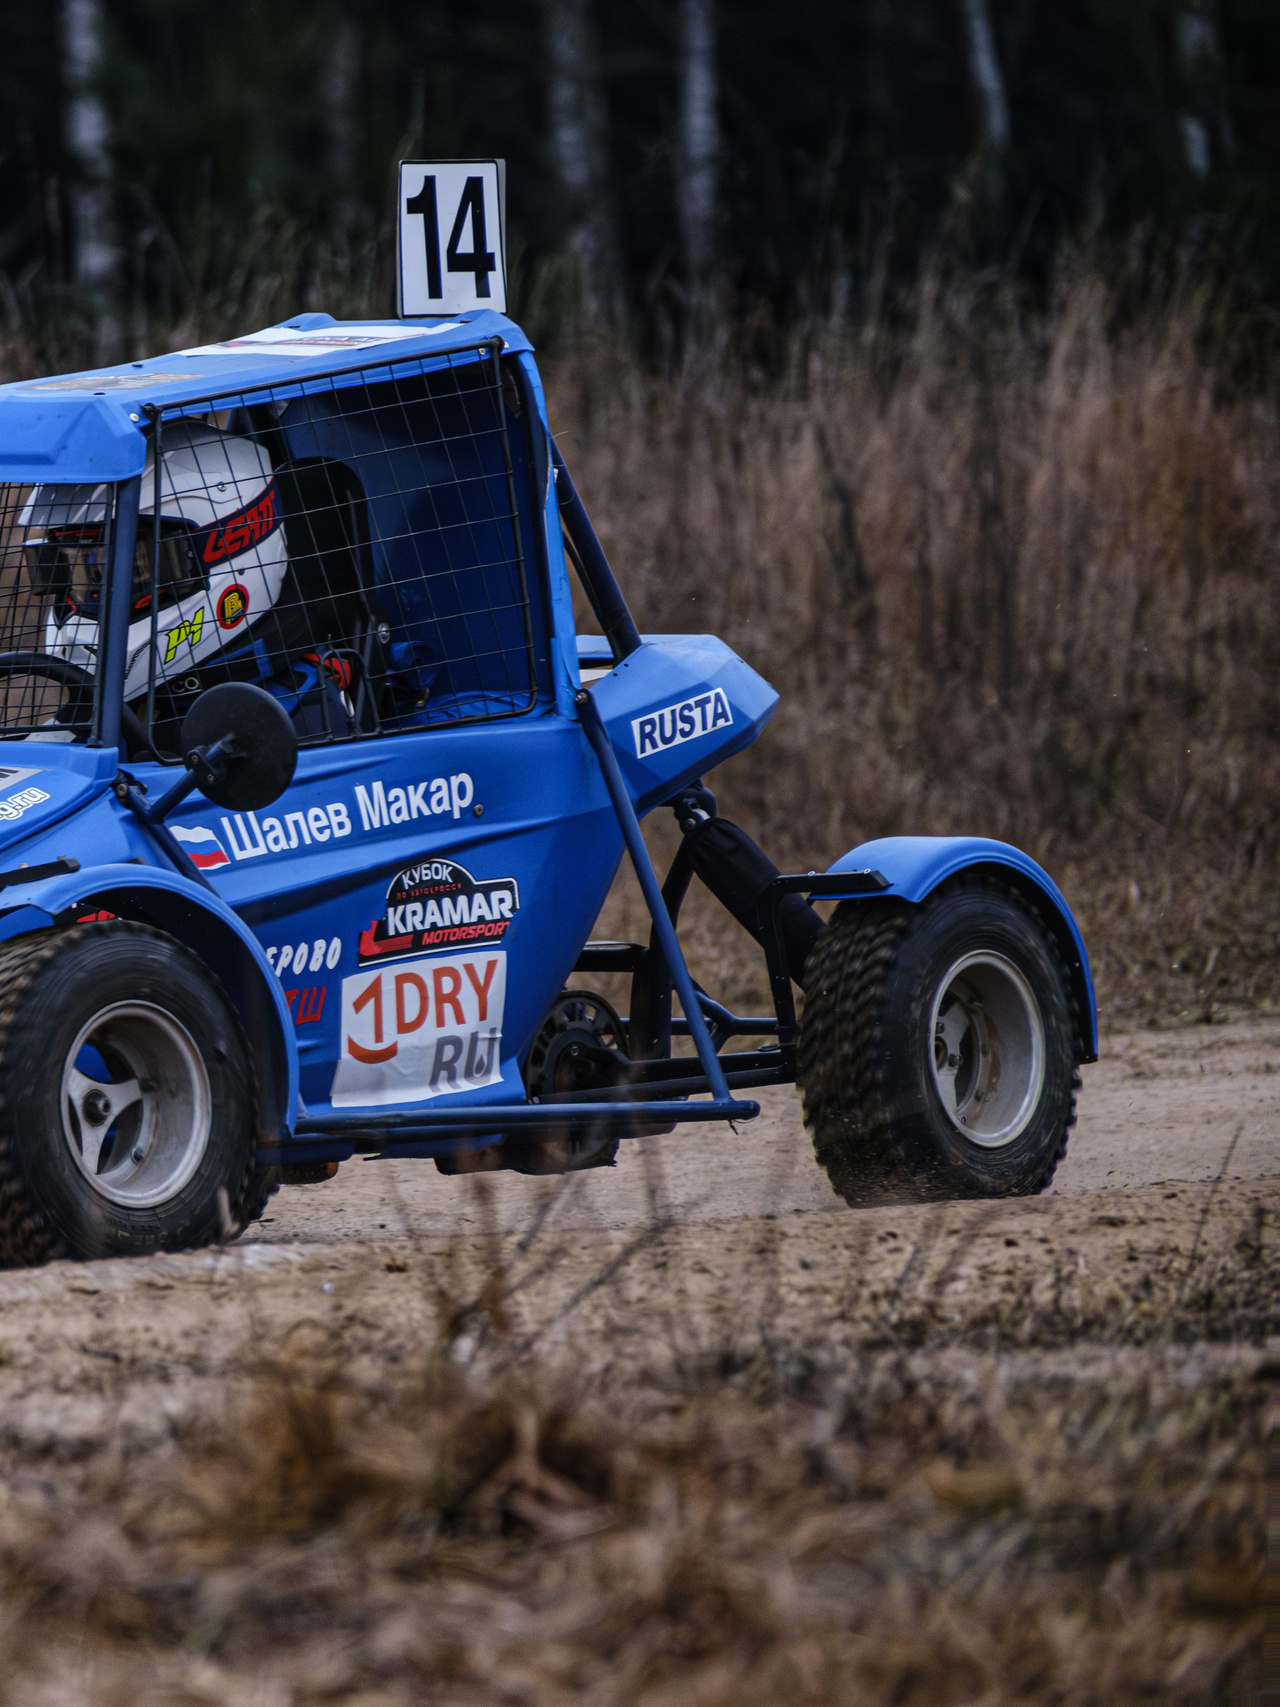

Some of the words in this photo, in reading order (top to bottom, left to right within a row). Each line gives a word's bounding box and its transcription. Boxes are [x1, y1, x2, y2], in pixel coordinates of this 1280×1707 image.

[407, 175, 496, 299] 14
[639, 692, 730, 754] RUSTA
[221, 803, 351, 860] Шалев
[355, 773, 473, 830] Макар
[401, 863, 453, 890] КУБОК
[387, 890, 514, 936] KRAMAR
[422, 921, 510, 946] MOTORSPORT
[352, 959, 499, 1044] 1DRY
[429, 1027, 497, 1093] RU
